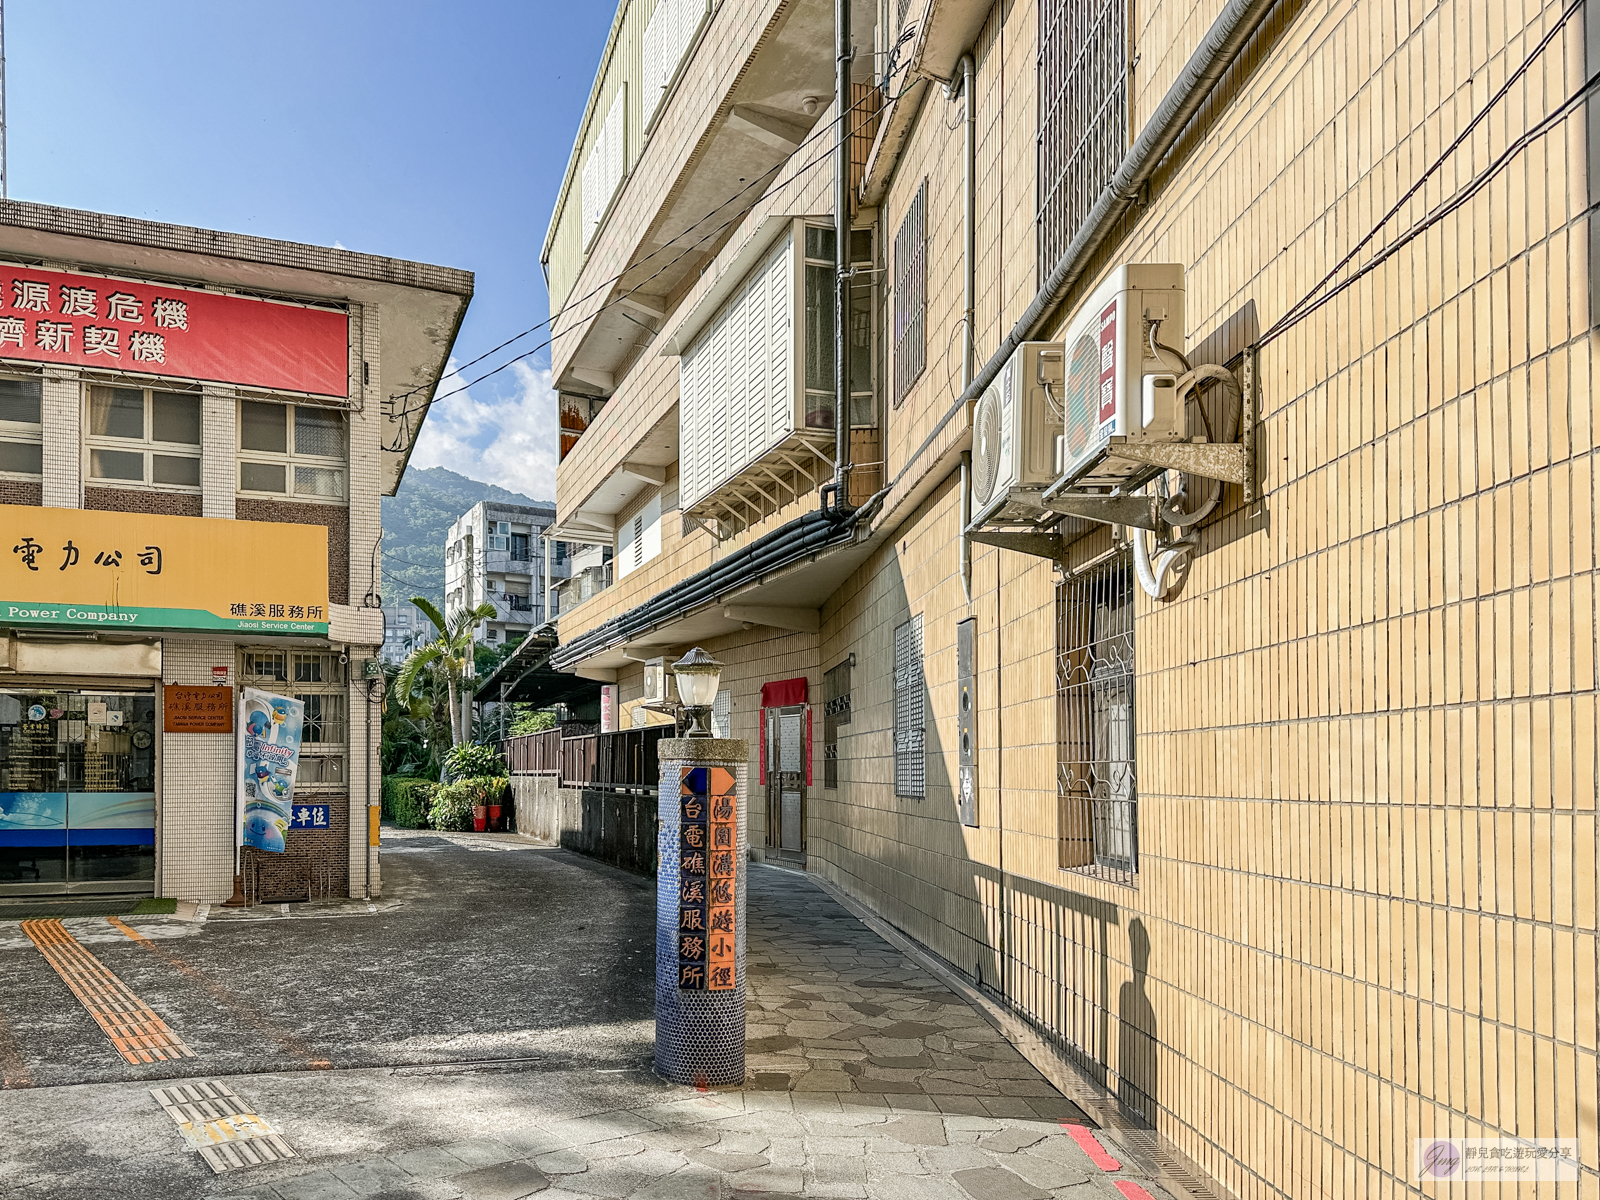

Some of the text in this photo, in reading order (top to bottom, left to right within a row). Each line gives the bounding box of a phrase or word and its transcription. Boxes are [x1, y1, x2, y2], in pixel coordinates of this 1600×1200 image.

[0, 280, 189, 330] 源渡危機
[12, 537, 163, 575] 電力公司
[8, 606, 138, 623] Power Company
[230, 603, 324, 619] 礁溪服務所
[238, 621, 315, 630] Jiaosi Service Center
[175, 691, 223, 701] 台灣電力公司
[168, 702, 229, 712] 礁溪服務所
[262, 744, 293, 758] Infinity
[680, 796, 706, 989] 台電礁溪服務所
[710, 797, 734, 988] 湯圍溝悠遊小徑
